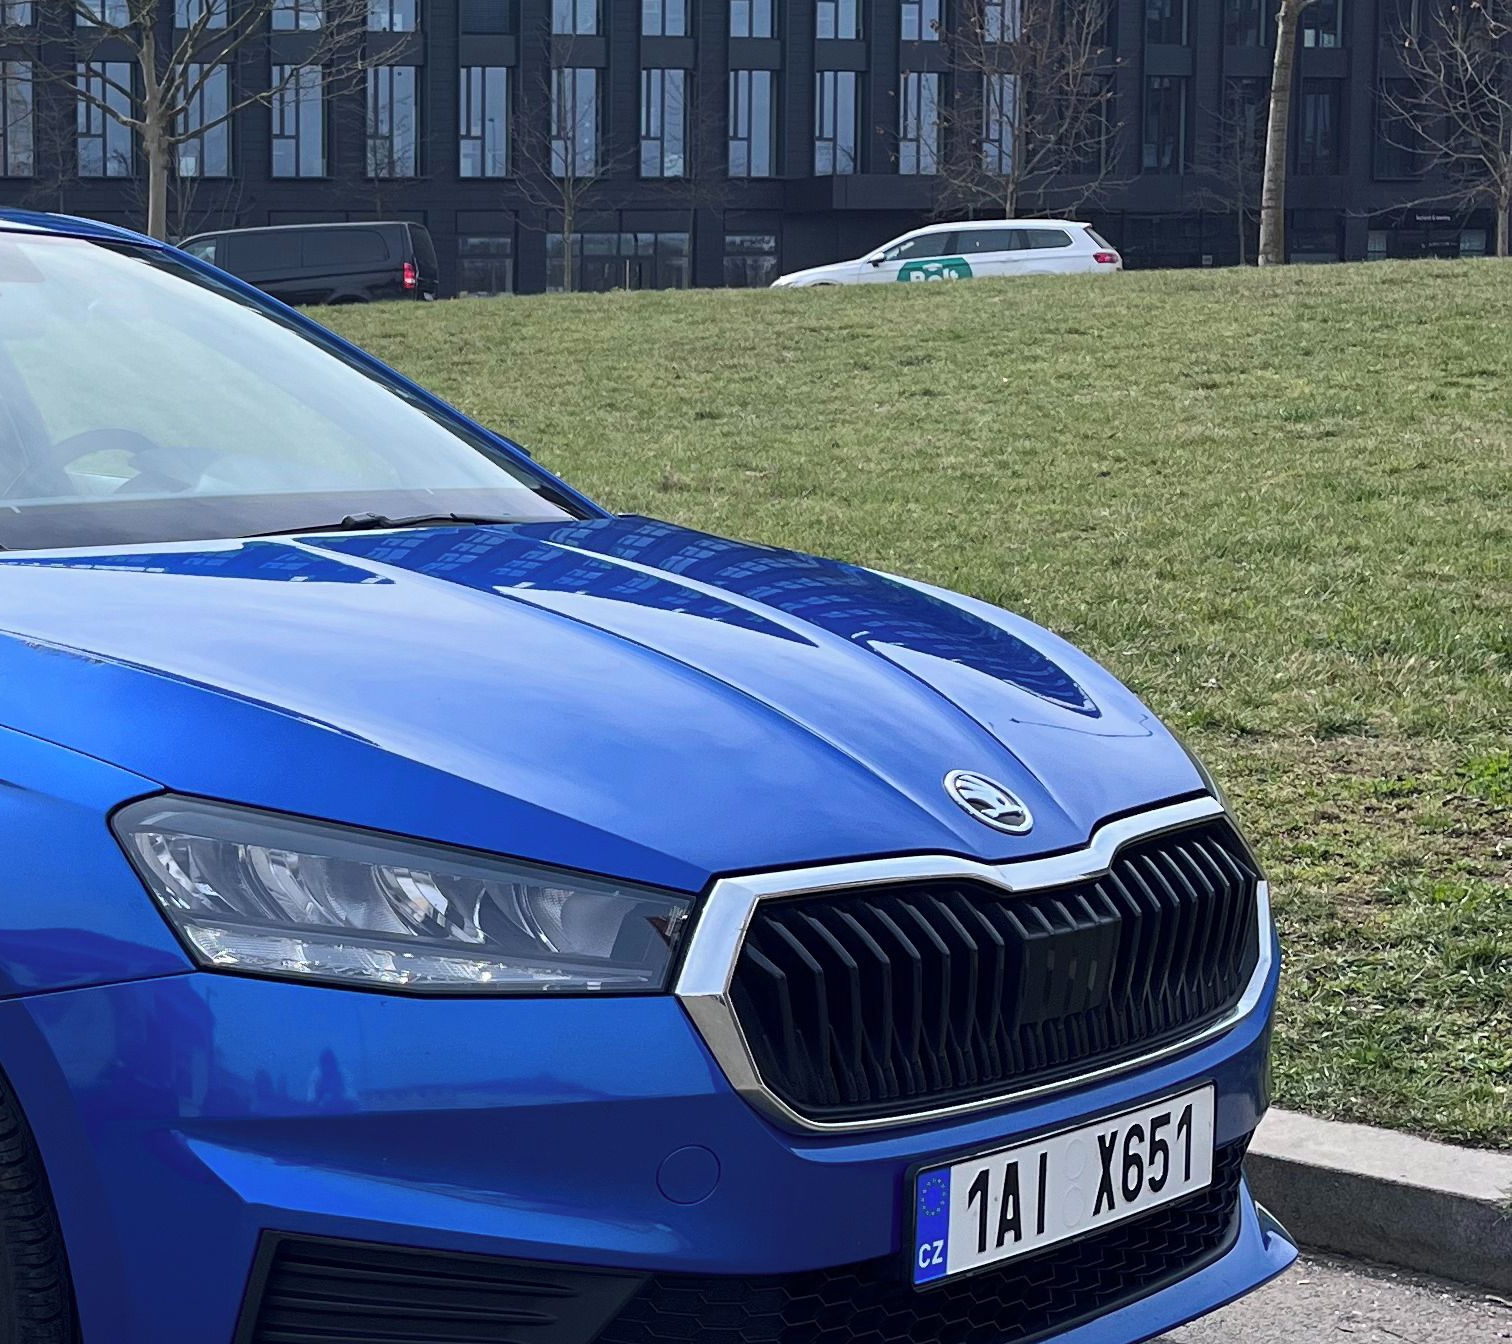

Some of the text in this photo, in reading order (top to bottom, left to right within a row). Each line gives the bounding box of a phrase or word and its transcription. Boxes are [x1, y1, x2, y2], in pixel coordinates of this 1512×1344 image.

[967, 1103, 1193, 1255] 1AI X651
[918, 1239, 945, 1269] CZ
